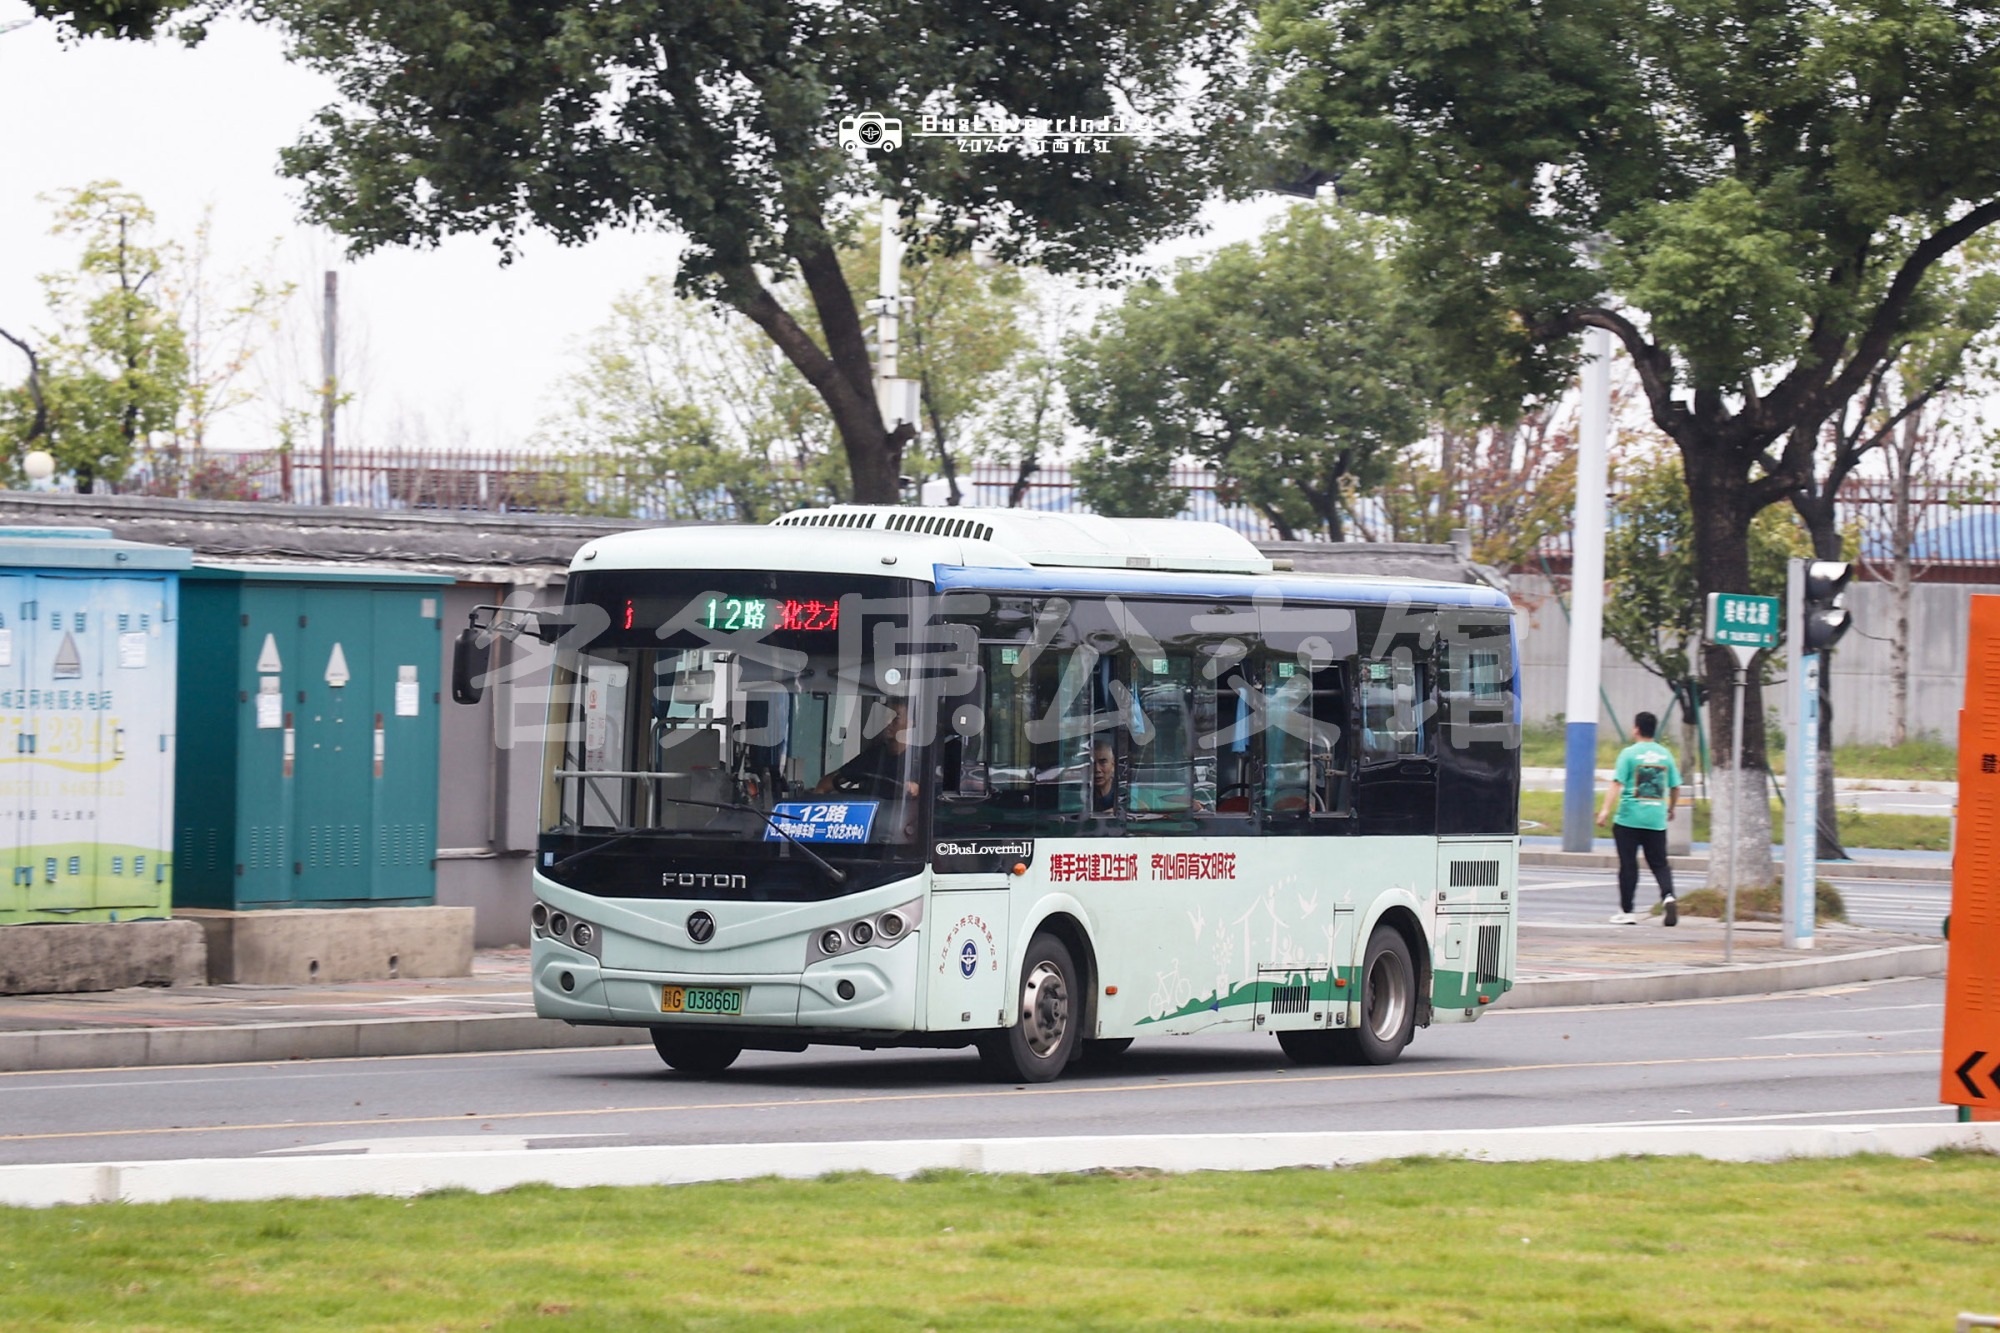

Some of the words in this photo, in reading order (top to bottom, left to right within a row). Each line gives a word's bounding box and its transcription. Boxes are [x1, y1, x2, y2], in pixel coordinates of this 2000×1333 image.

[707, 598, 766, 630] 12路
[799, 805, 849, 823] 12路
[1050, 853, 1138, 882] 携手共建卫生城
[1150, 852, 1236, 881] 齐心同育文明花
[662, 872, 747, 889] FOTON
